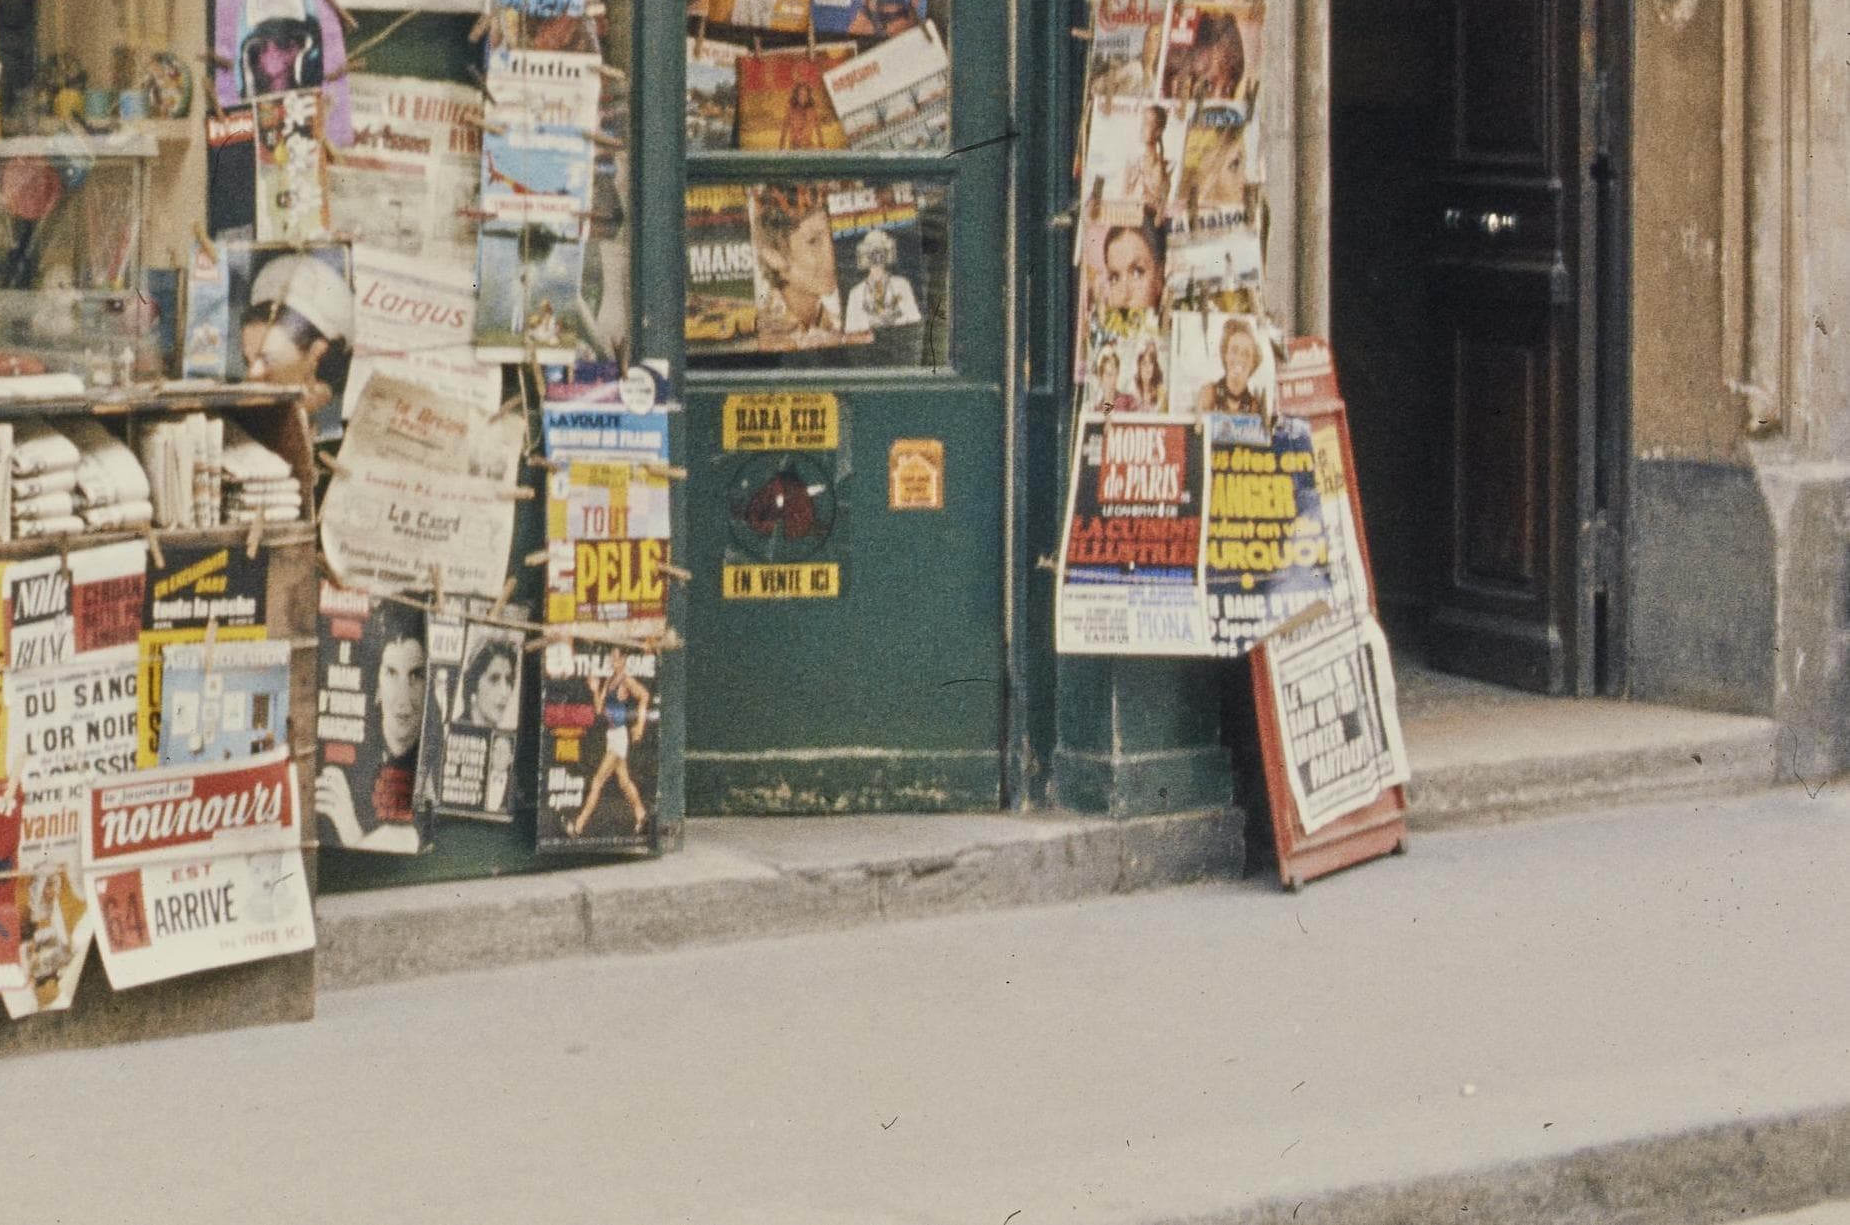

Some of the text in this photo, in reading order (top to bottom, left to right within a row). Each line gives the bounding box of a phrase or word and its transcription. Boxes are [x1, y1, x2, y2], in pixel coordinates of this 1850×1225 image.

[1106, 426, 1167, 464] MODES
[1124, 463, 1180, 501] PARIS
[759, 567, 802, 593] VENTE
[810, 567, 831, 593] ICI
[24, 674, 139, 719] DU SANG
[25, 725, 76, 757] L'OR
[24, 786, 62, 806] ENTE
[101, 780, 283, 849] nounours
[154, 878, 238, 938] ARRIVÉ
